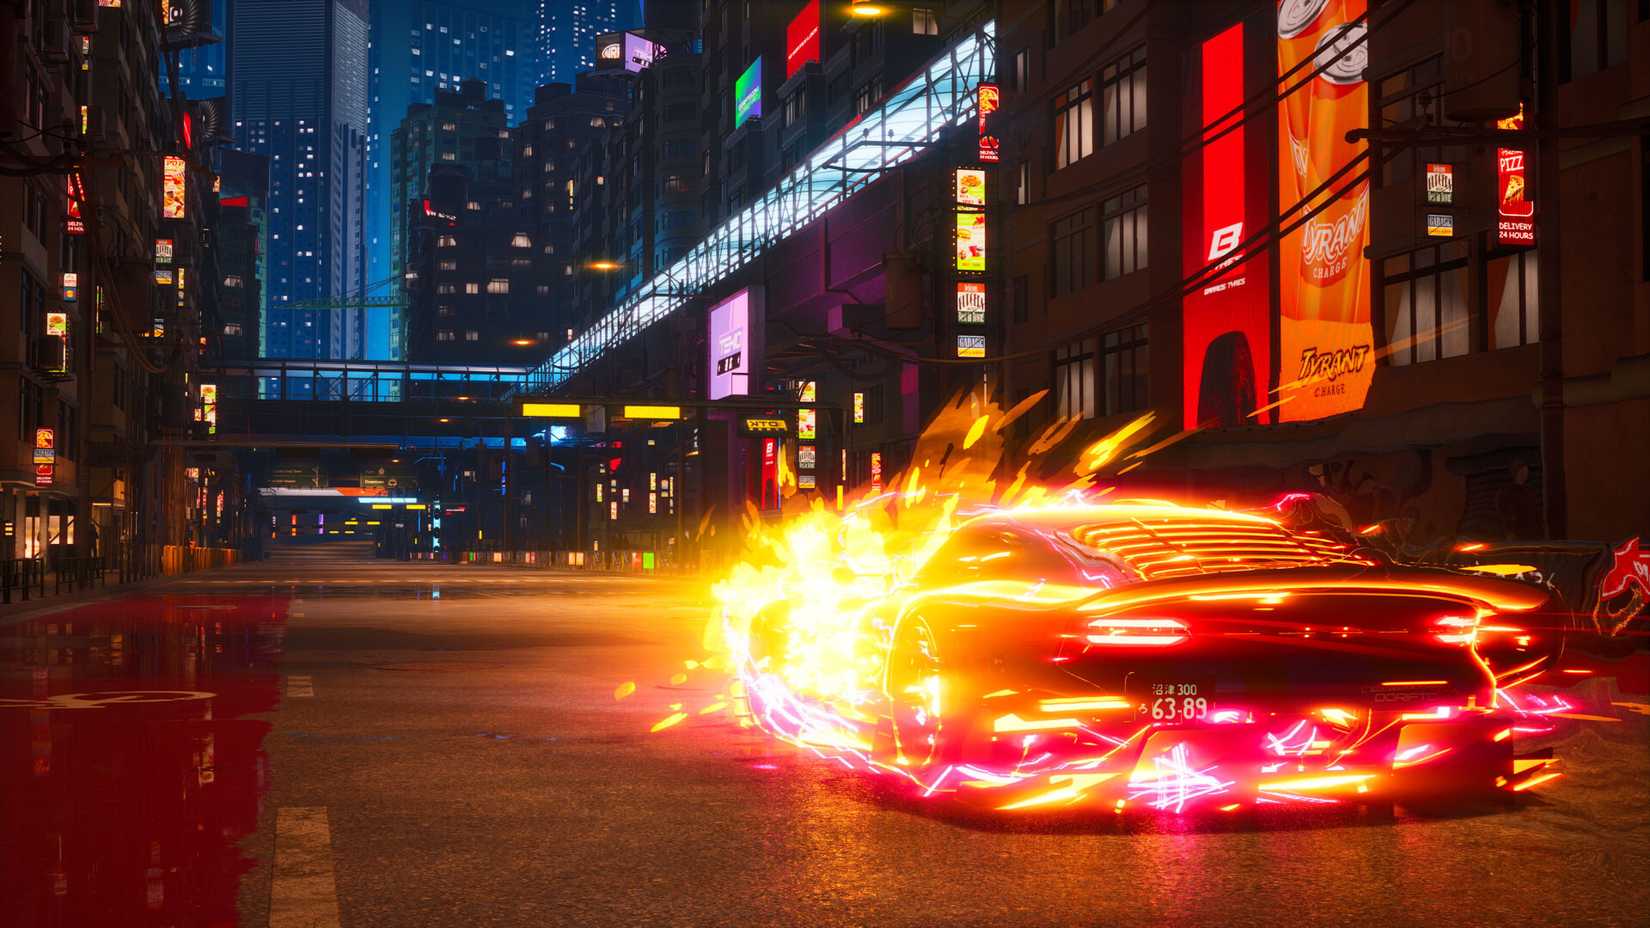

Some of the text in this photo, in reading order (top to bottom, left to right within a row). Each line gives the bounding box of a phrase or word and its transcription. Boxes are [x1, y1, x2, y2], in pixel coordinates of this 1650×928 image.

[1499, 222, 1532, 230] DELIVERY
[1313, 256, 1347, 278] CHARGE
[1297, 344, 1369, 382] TYRANT
[1314, 384, 1345, 397] CHARGE
[1177, 684, 1197, 695] 300
[1152, 698, 1207, 719] 63-89
